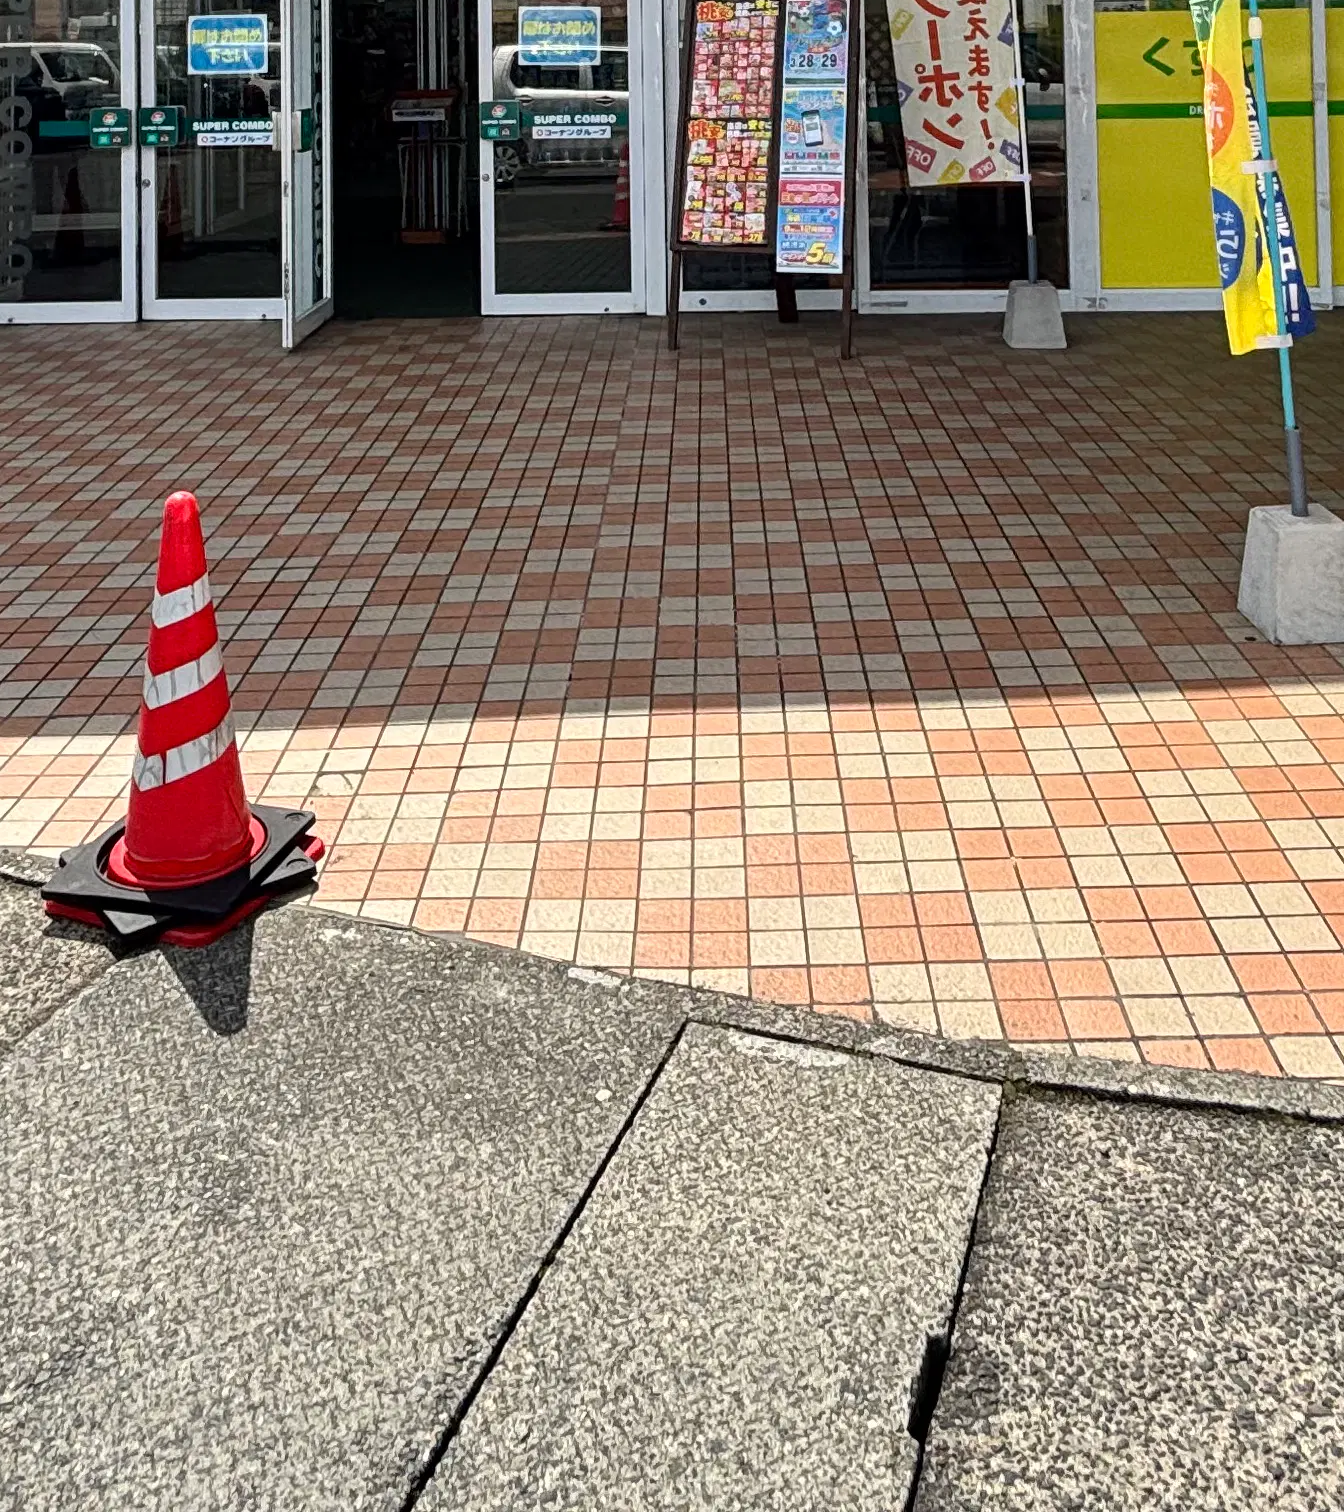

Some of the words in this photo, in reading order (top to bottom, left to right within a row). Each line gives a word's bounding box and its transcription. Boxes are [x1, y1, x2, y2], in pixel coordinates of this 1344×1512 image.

[798, 55, 814, 67] 28
[821, 54, 838, 67] 29
[534, 115, 571, 124] SUPER
[574, 114, 617, 124] COMBO
[192, 121, 229, 131] SUPER
[232, 121, 273, 131] COMBO
[545, 128, 607, 137] コーナングループ
[208, 135, 271, 144] コーナングループ
